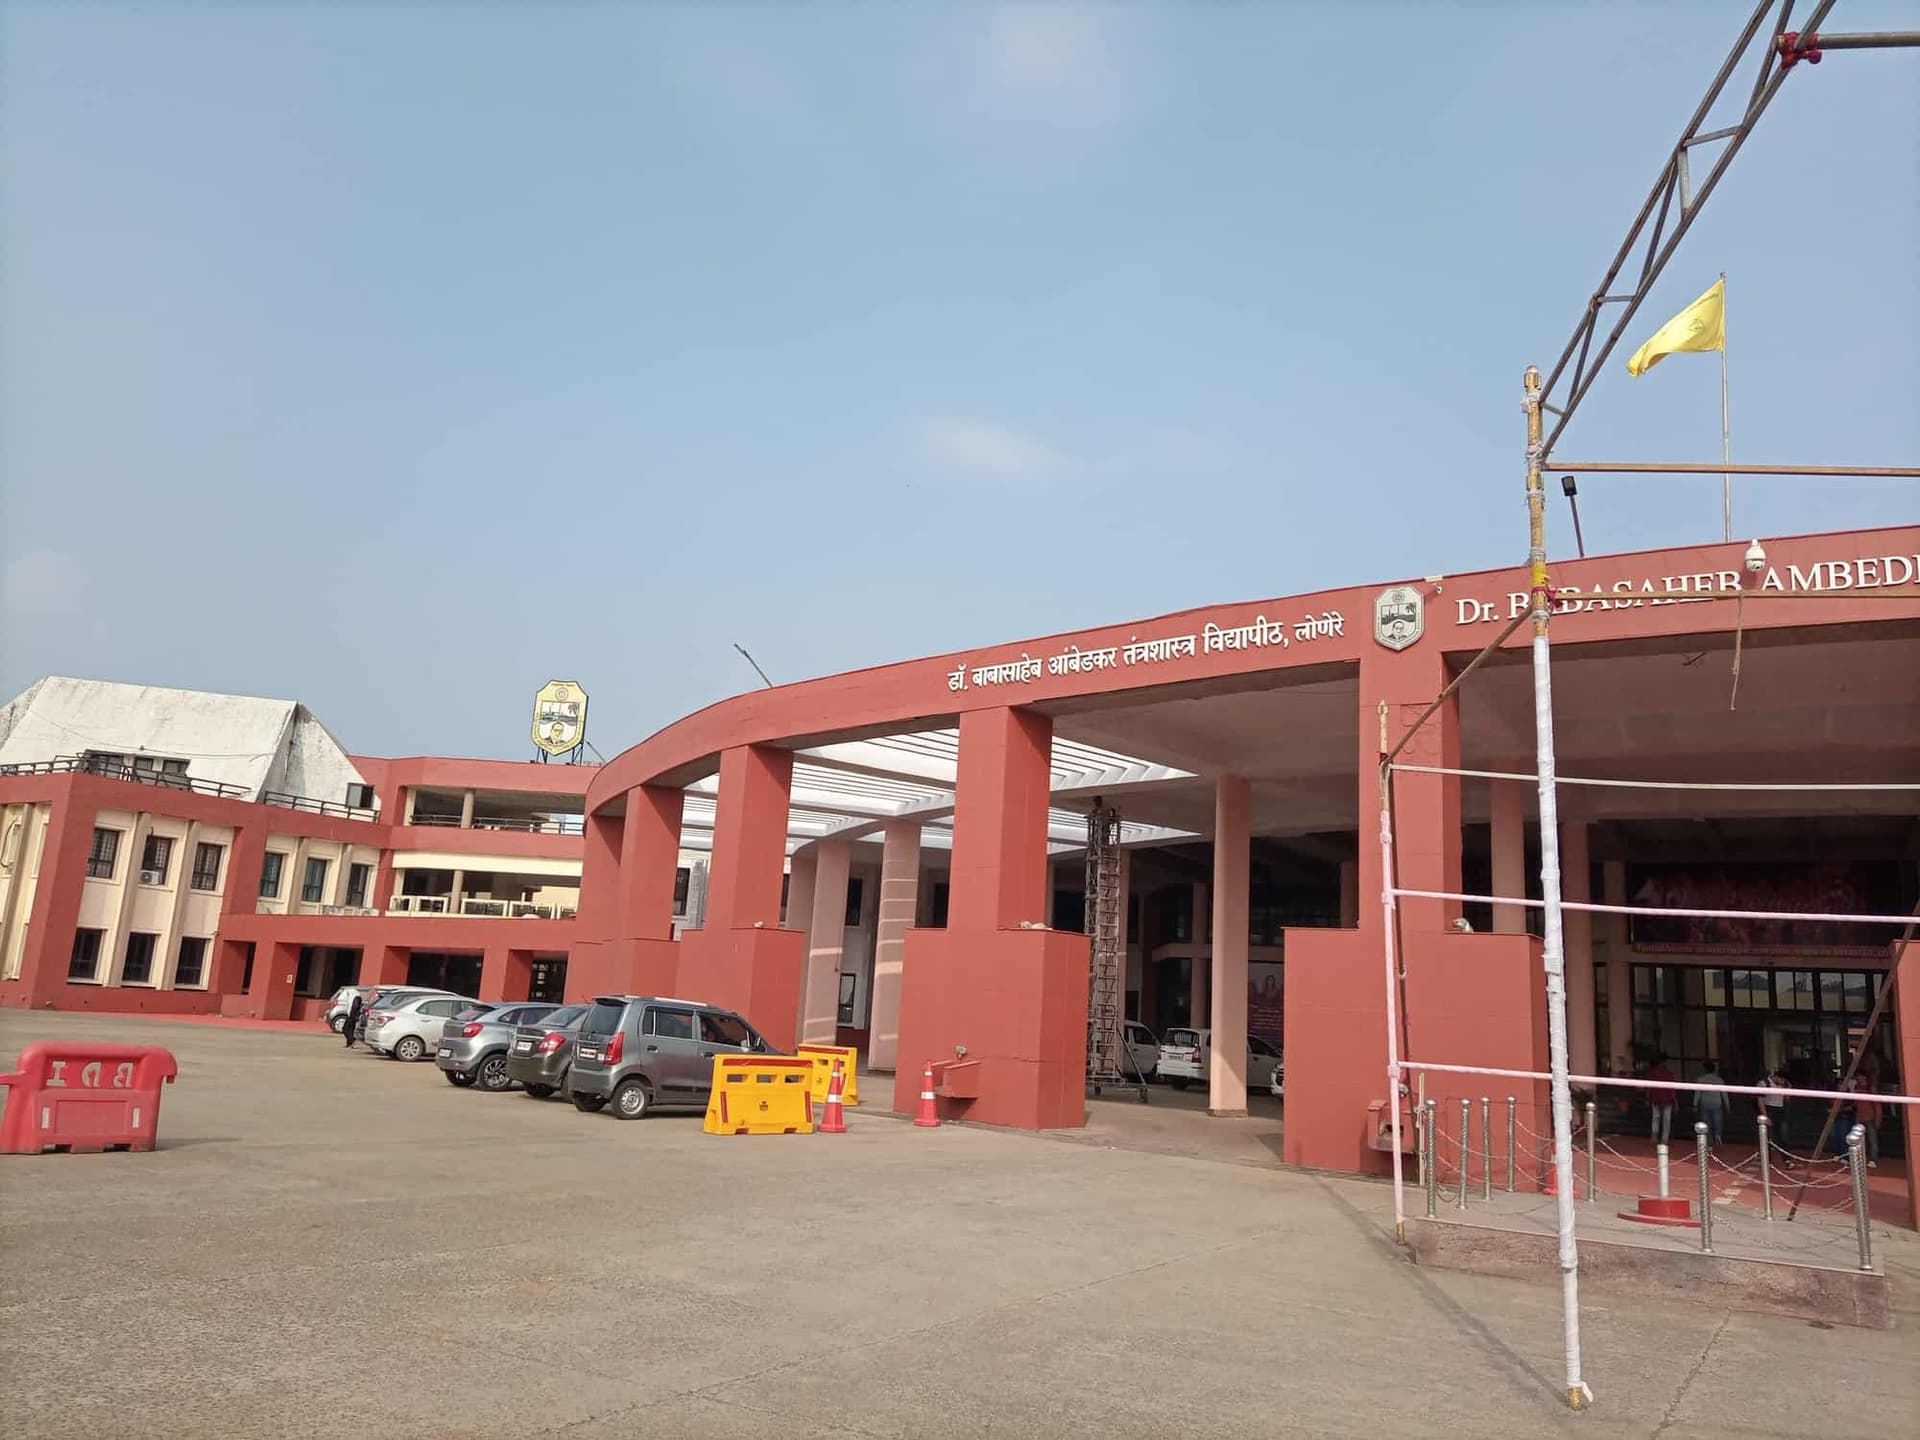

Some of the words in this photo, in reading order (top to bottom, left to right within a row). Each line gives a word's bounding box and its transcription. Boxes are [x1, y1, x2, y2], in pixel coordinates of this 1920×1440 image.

[1456, 597, 1499, 625] Dr.
[947, 663, 969, 690] डॉ.
[971, 653, 1043, 686] बाबासाहेब
[1048, 645, 1118, 675] आंबेडकर
[1121, 635, 1197, 665] तंत्रशास्त्र
[1202, 615, 1289, 654] विद्यापीठ,
[1293, 611, 1345, 641] लोणेरे
